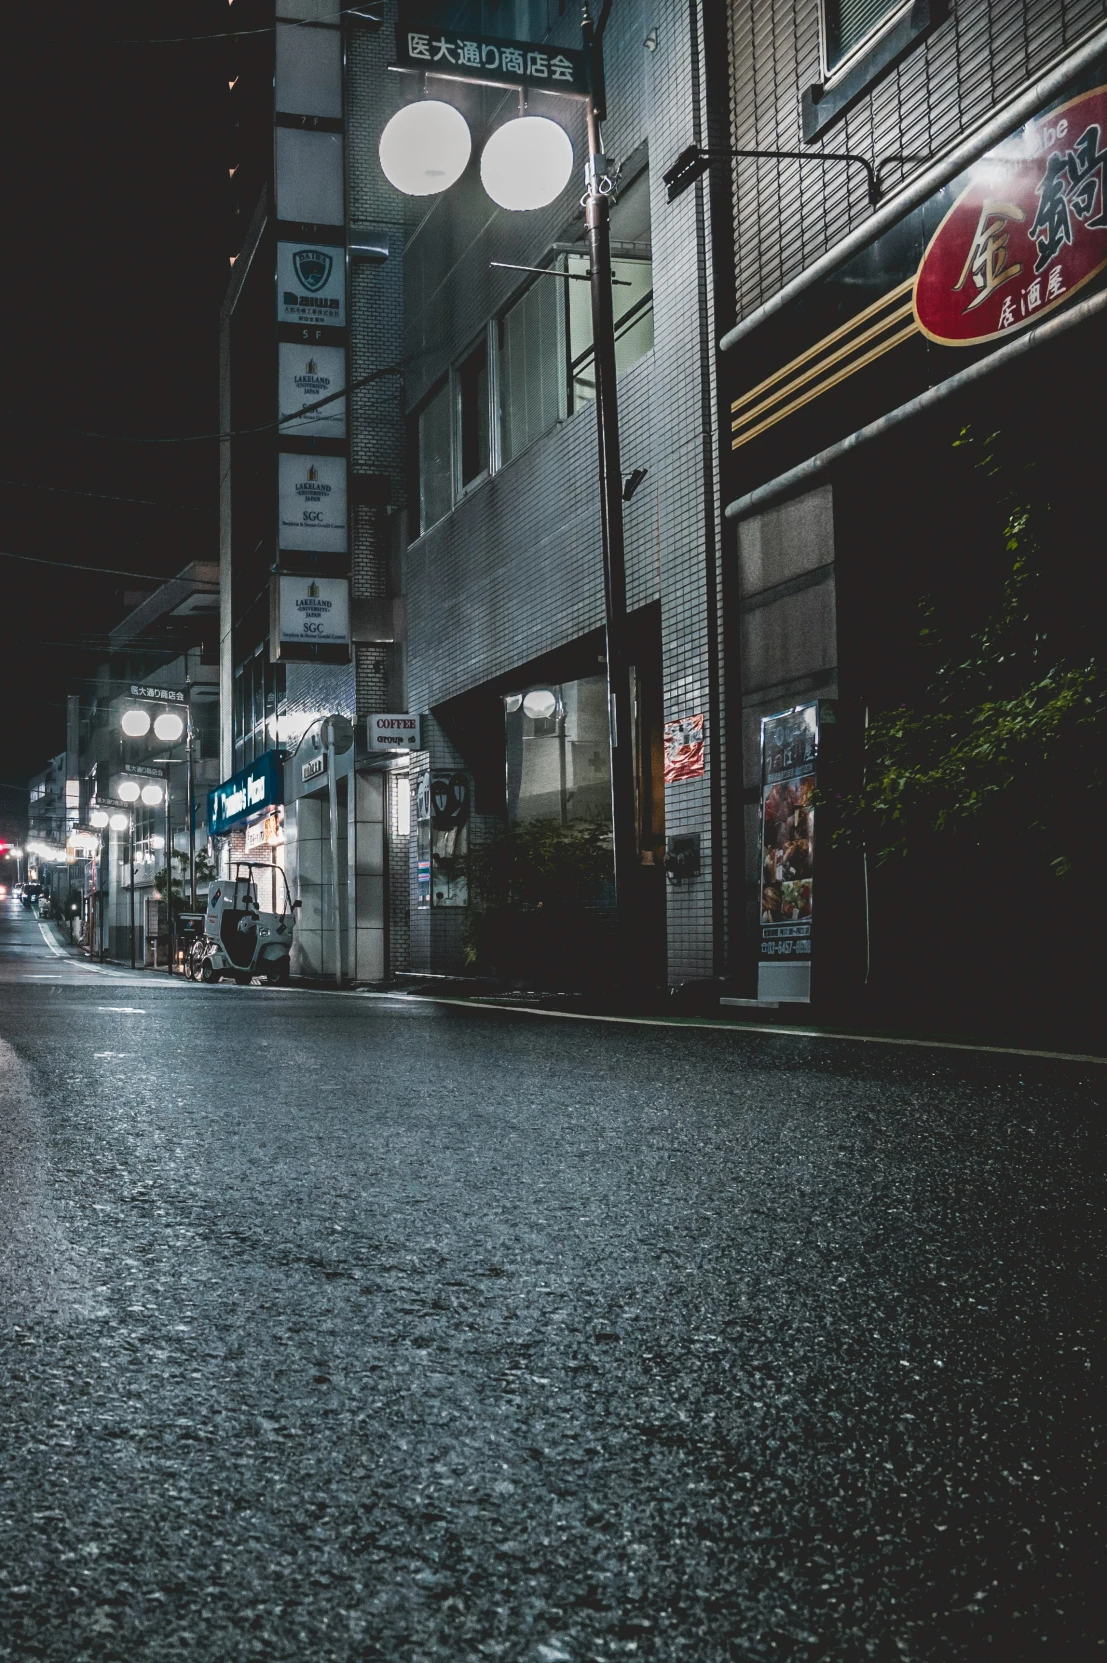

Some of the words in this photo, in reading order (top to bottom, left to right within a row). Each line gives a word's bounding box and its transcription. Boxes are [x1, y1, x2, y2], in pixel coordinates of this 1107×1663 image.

[408, 32, 573, 82] 医大通り商店会
[299, 253, 327, 264] DAIWA
[283, 291, 339, 309] Daiwa
[998, 264, 1067, 330] 居酒屋
[294, 375, 330, 385] LAKELAND
[296, 382, 328, 390] UNIVERSITY
[295, 483, 331, 492] LAKELAND
[303, 510, 323, 522] SGC
[295, 599, 332, 608] LAKELAND
[303, 622, 324, 634] SGC
[130, 685, 184, 702] 医大通り商店会
[377, 718, 416, 729] COFFEE
